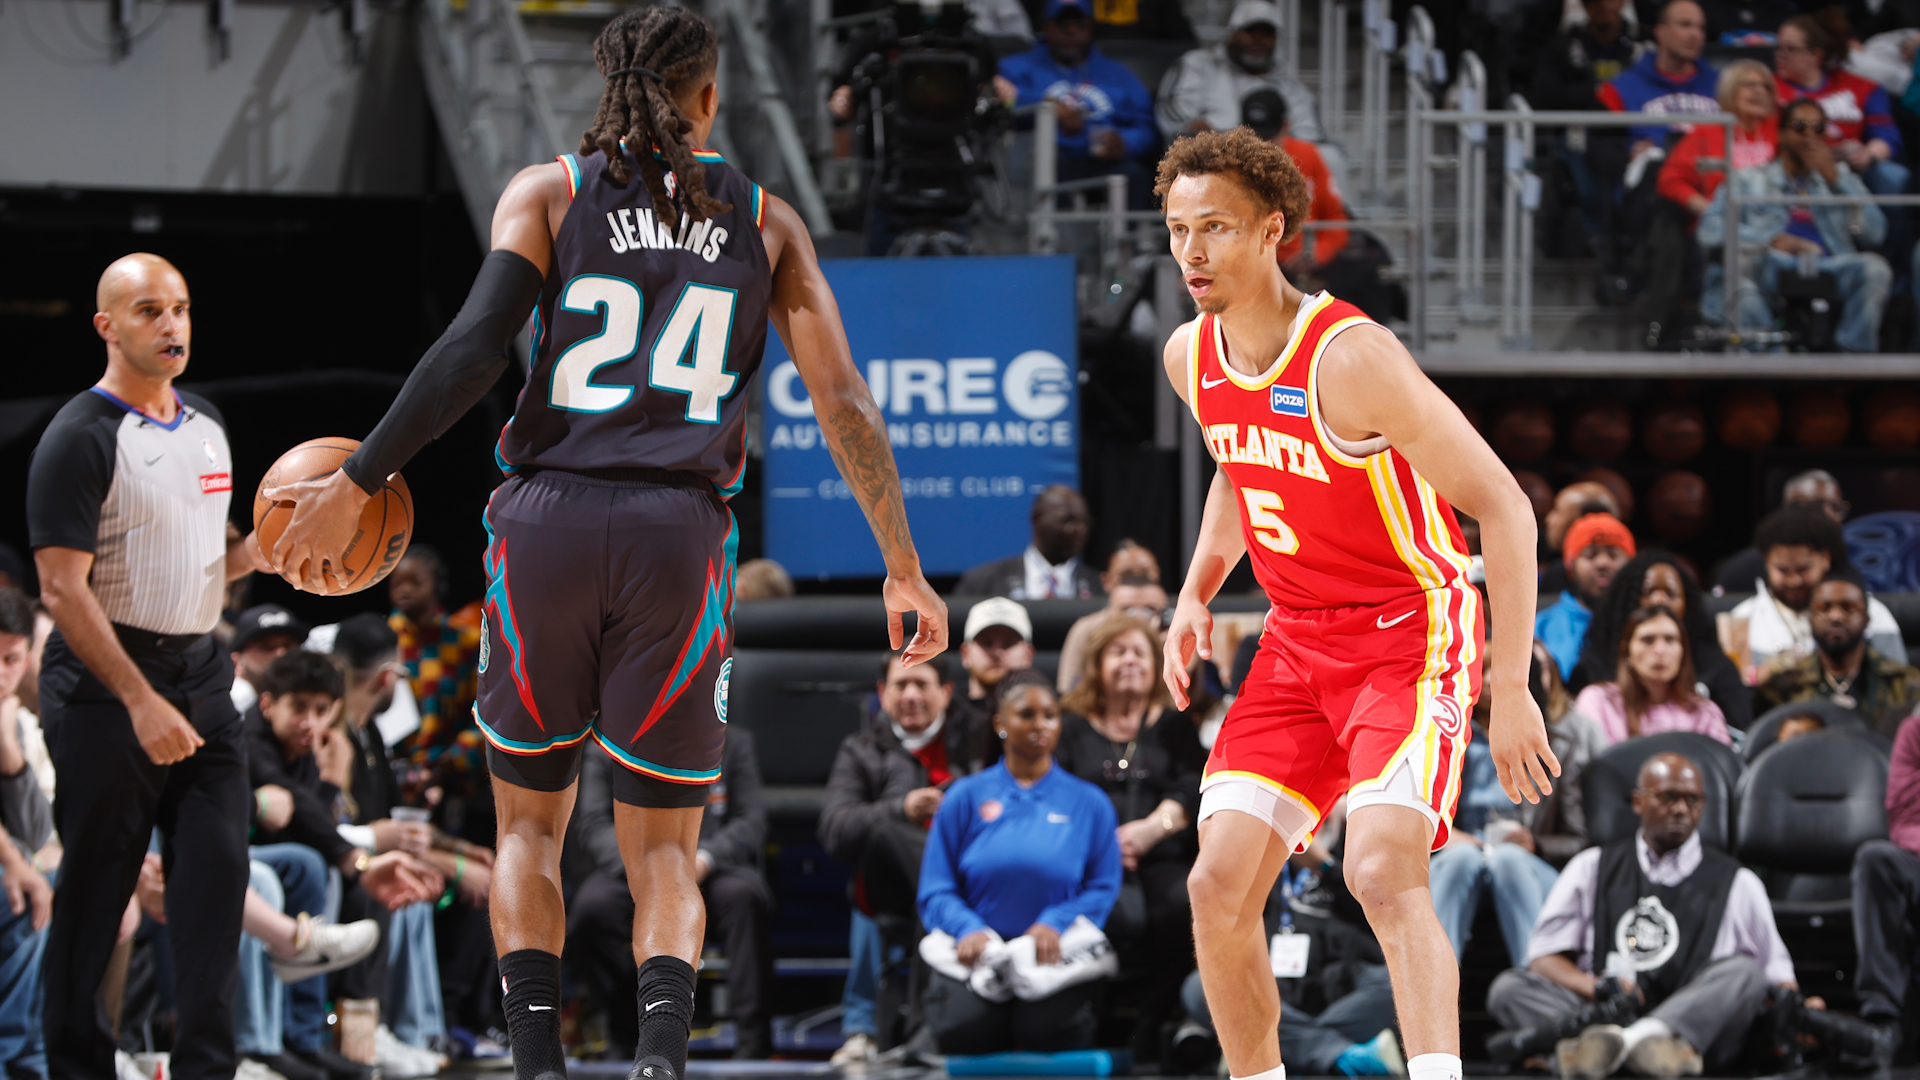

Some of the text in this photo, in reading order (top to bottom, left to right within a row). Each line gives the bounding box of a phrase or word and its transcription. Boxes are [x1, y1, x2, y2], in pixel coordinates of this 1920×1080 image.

[547, 272, 740, 425] 24
[1274, 392, 1305, 407] paze
[769, 423, 828, 450] AU
[886, 420, 1073, 448] NSURANCE
[1205, 423, 1331, 484] TLANTA
[960, 475, 1025, 498] CLUB
[1240, 486, 1301, 557] 5
